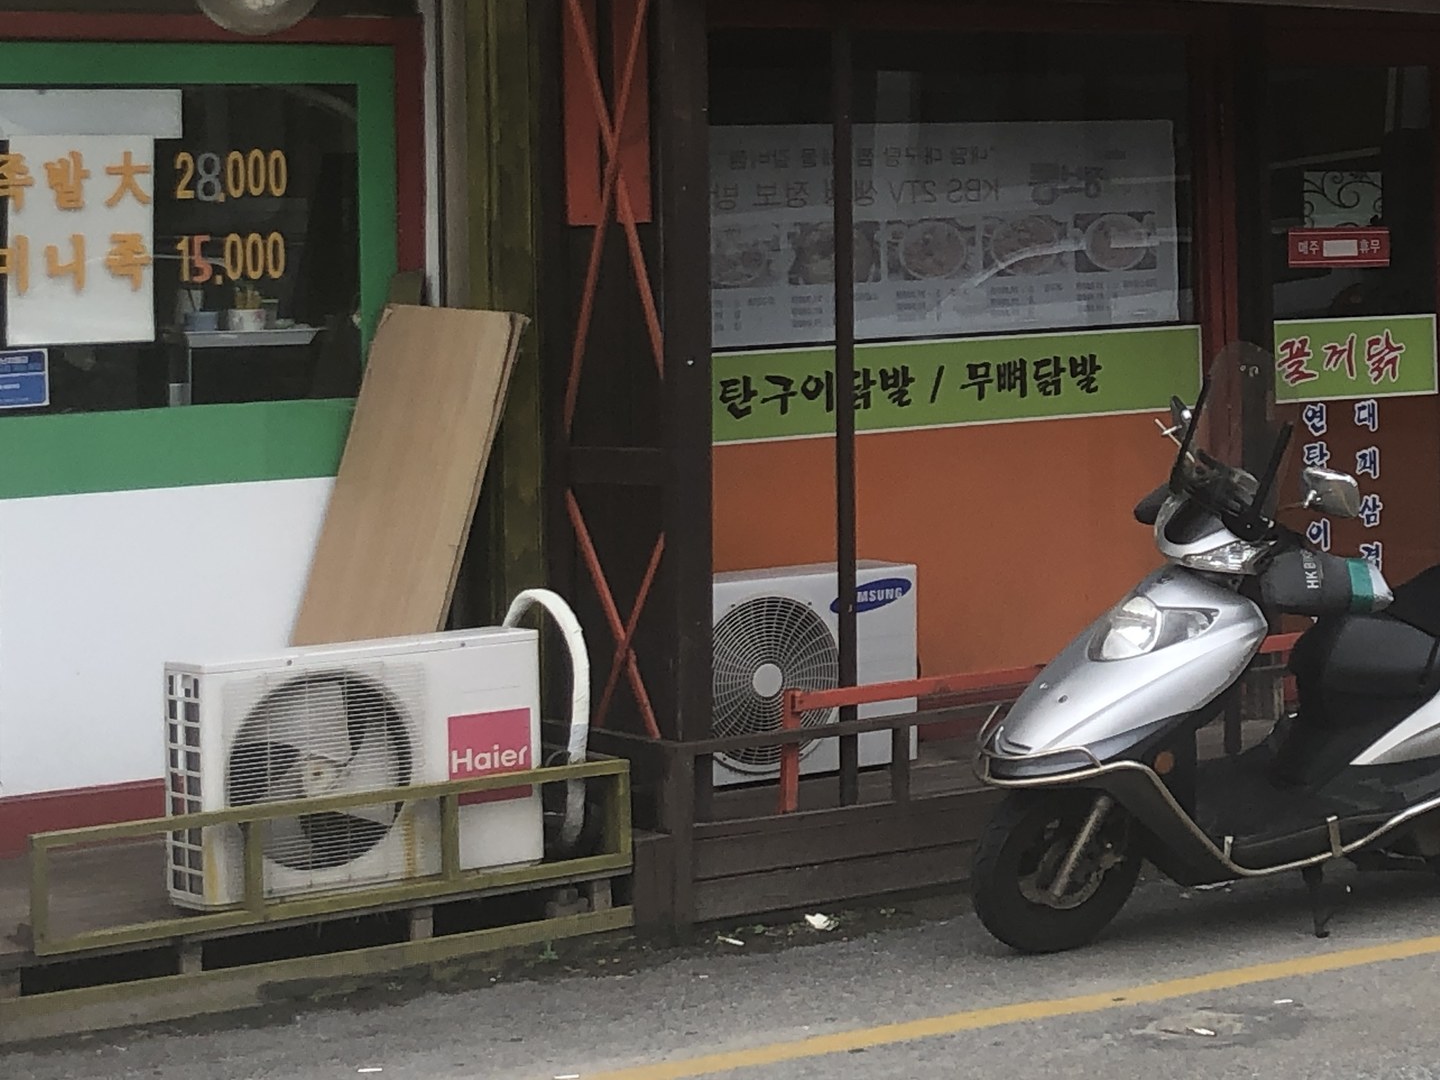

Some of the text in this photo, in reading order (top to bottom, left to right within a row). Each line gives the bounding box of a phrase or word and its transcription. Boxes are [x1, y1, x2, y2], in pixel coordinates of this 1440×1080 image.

[1360, 238, 1380, 254] 휴무
[960, 353, 1102, 401] 무뼈닭발
[451, 743, 528, 773] Haier
